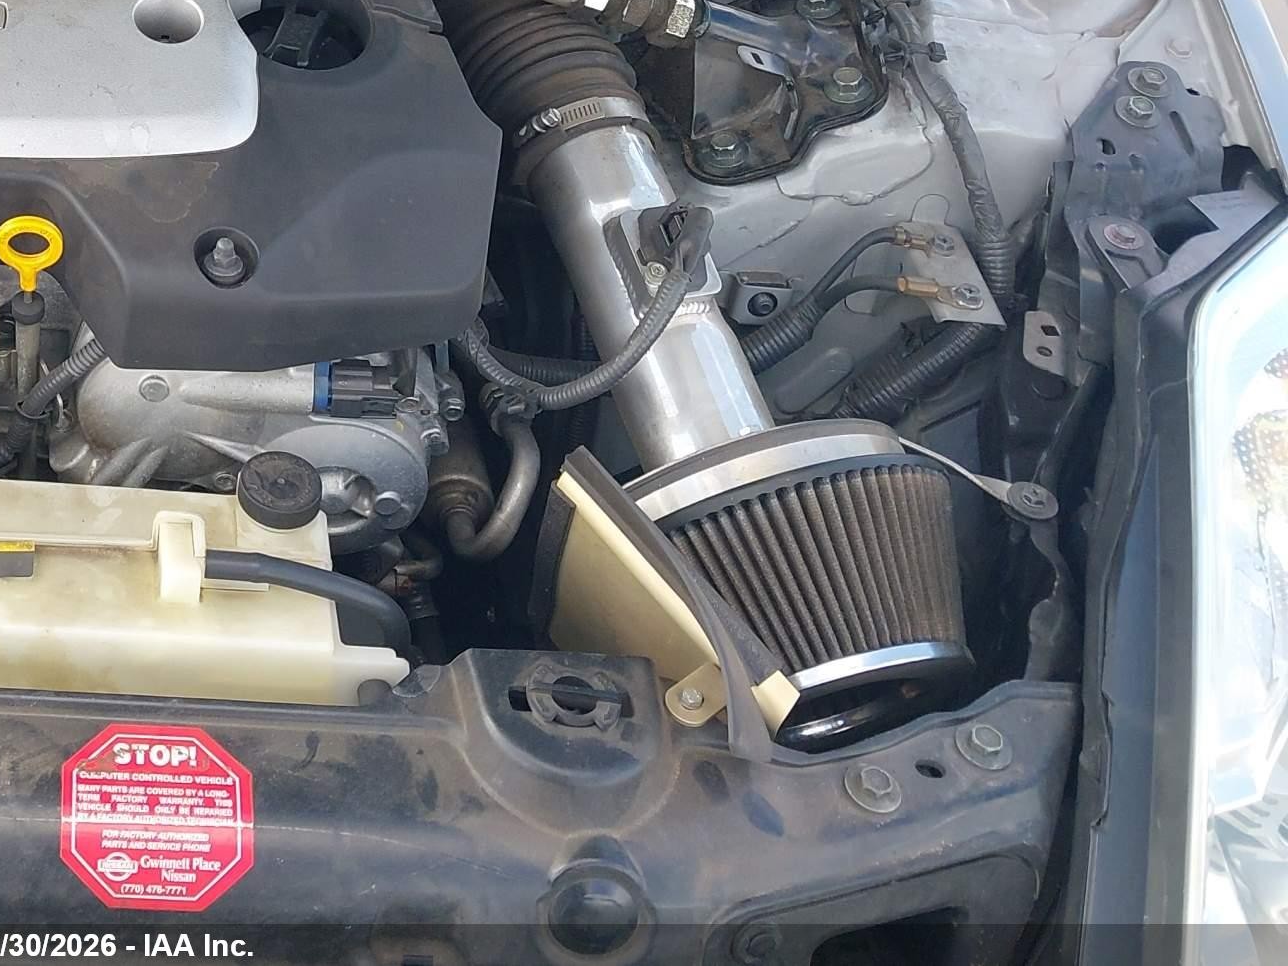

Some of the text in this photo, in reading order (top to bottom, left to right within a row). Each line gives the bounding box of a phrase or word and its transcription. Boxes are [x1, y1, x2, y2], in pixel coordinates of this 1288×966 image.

[112, 743, 197, 767] STOP!
[132, 773, 193, 784] CONTROLLED
[195, 776, 233, 785] VEHICLE
[78, 784, 101, 792] MANY
[102, 785, 128, 794] PARTS
[128, 786, 146, 794] ARE
[146, 787, 184, 796] COVERED
[185, 788, 198, 796] BY
[78, 793, 101, 802] TERM
[111, 794, 148, 803] FACTORY
[215, 799, 233, 808] THIS
[78, 802, 112, 811] VEHICLE
[116, 804, 150, 813] SHOULD
[154, 806, 176, 814] ONLY
[179, 806, 190, 815] BE
[119, 830, 157, 840] FACTORY
[156, 831, 210, 841] AUTHORIZED
[102, 840, 212, 852] PARTS AND SERVICE PHONE
[141, 855, 221, 871] Gwinnett Place
[160, 869, 196, 883] Nissan
[120, 883, 145, 895] (770)
